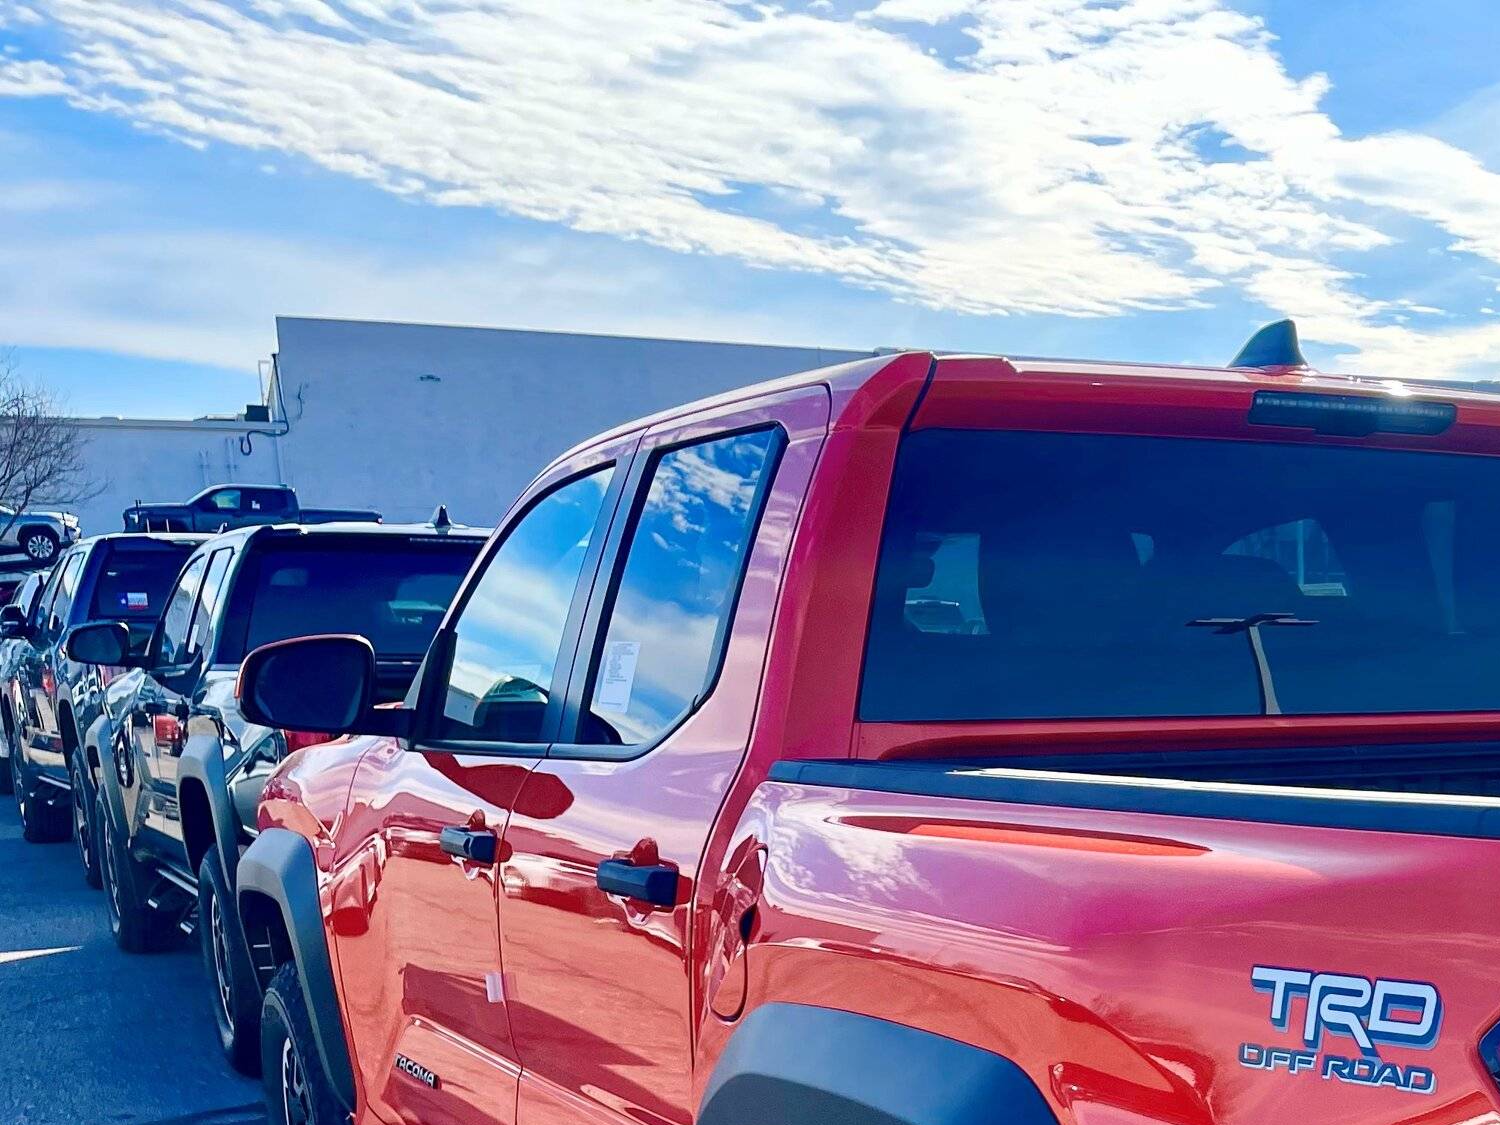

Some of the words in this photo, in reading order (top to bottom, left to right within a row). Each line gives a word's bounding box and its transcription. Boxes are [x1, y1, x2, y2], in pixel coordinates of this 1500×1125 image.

[1251, 964, 1444, 1062] TRD
[394, 1053, 436, 1089] TACOMA
[1239, 1042, 1316, 1075] OFF
[1322, 1054, 1438, 1094] ROAD
